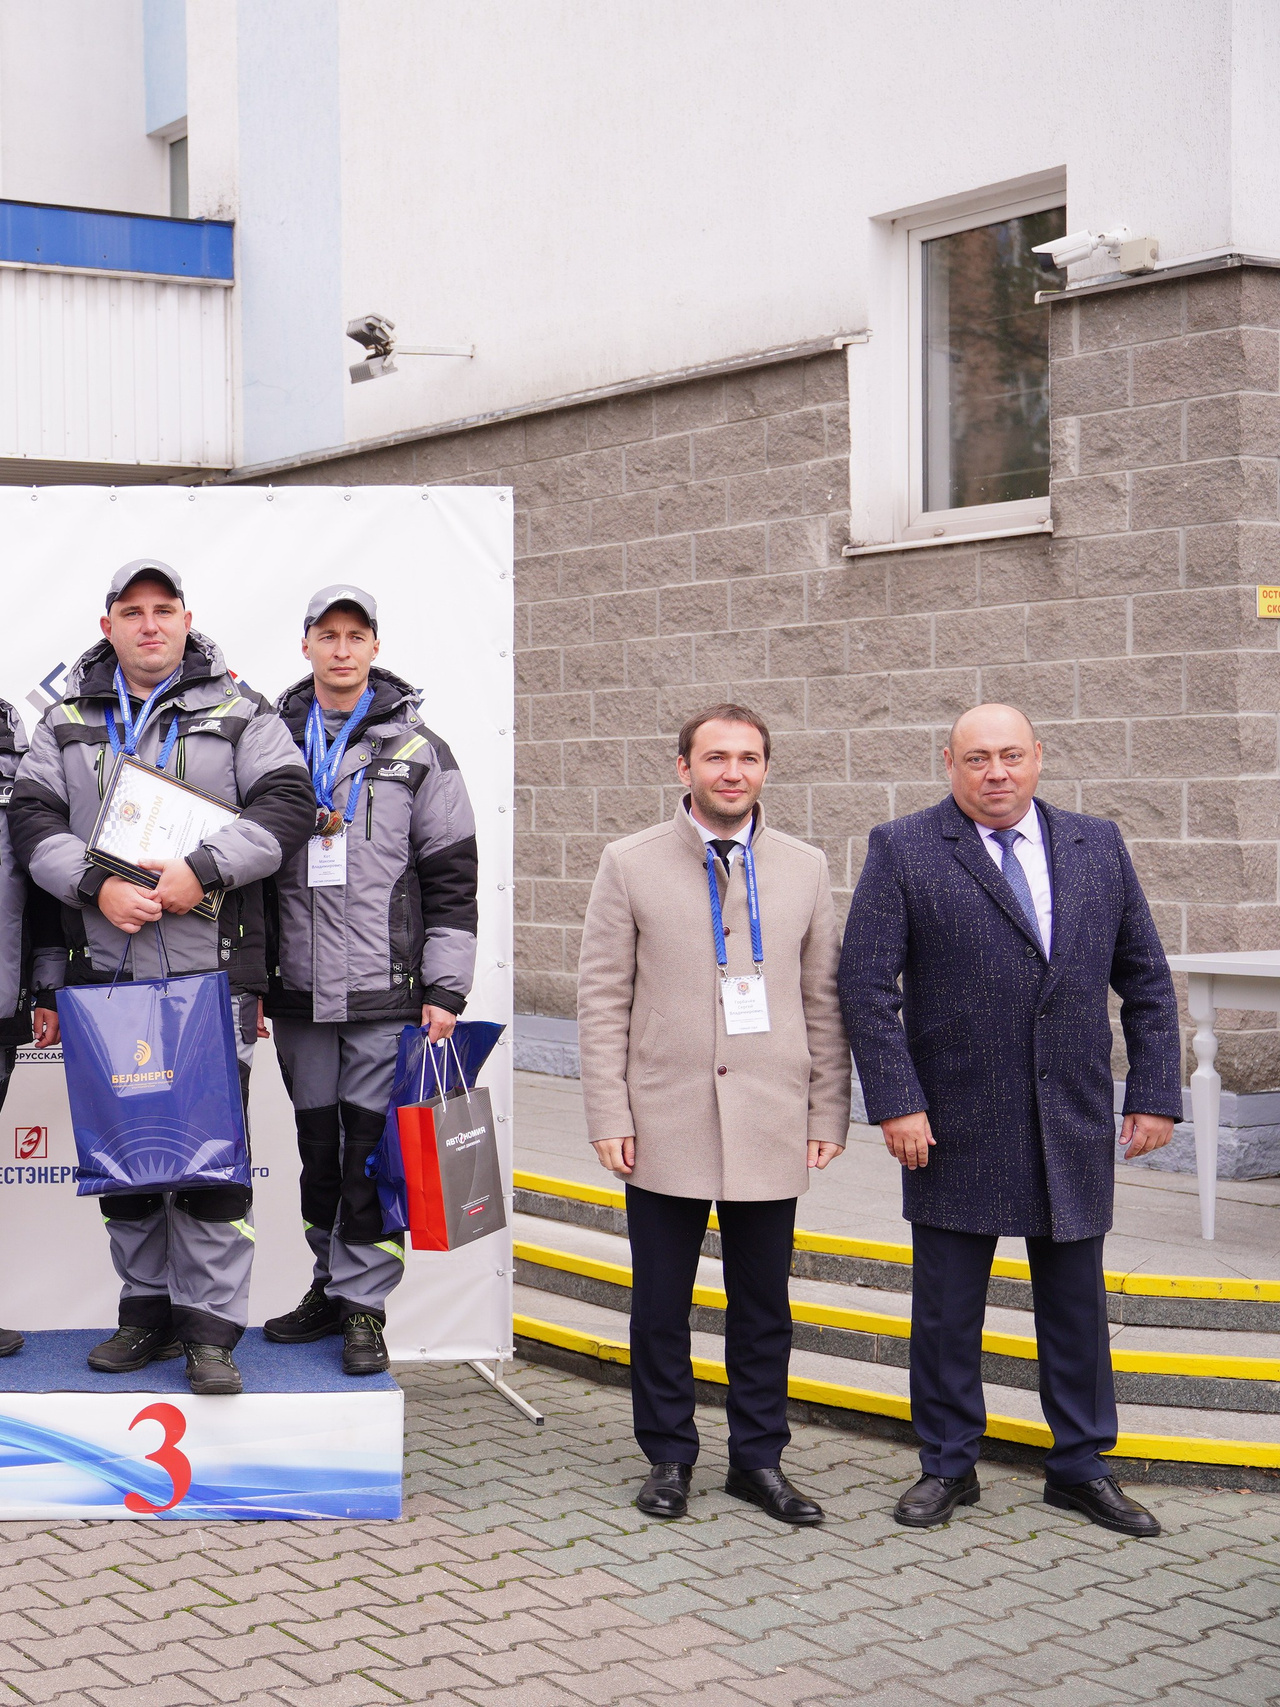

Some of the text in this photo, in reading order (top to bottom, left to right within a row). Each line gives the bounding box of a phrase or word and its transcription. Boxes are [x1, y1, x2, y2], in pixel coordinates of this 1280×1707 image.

[1262, 590, 1280, 599] ОСТ
[139, 795, 164, 852] ДИПЛОМ
[111, 1069, 174, 1084] БЕЛЭНЕРГО
[252, 1167, 269, 1178] ГО
[124, 1402, 192, 1514] 3
